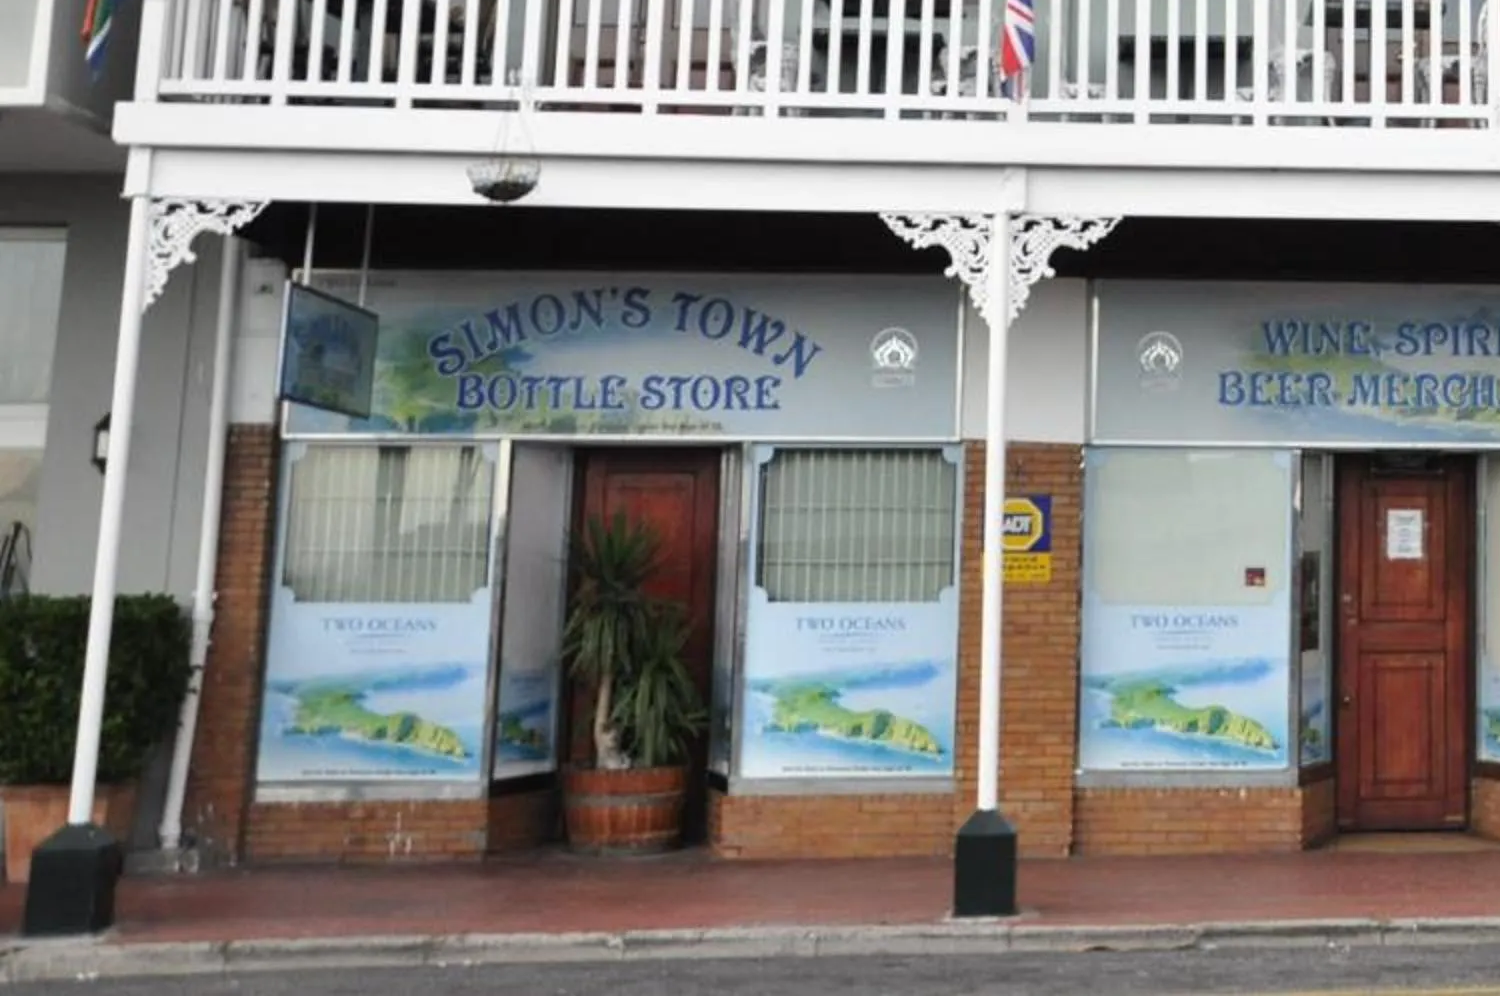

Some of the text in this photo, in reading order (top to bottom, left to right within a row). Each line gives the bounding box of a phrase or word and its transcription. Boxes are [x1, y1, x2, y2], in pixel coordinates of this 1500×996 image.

[429, 286, 651, 376] SIMON'S
[671, 291, 823, 380] TOWN
[456, 373, 783, 411] BOTTLE STORE
[1219, 371, 1339, 407] BEER
[1001, 514, 1031, 534] ADT
[320, 617, 364, 632] TWO
[795, 616, 835, 631] TWO
[1131, 613, 1169, 629] TWO
